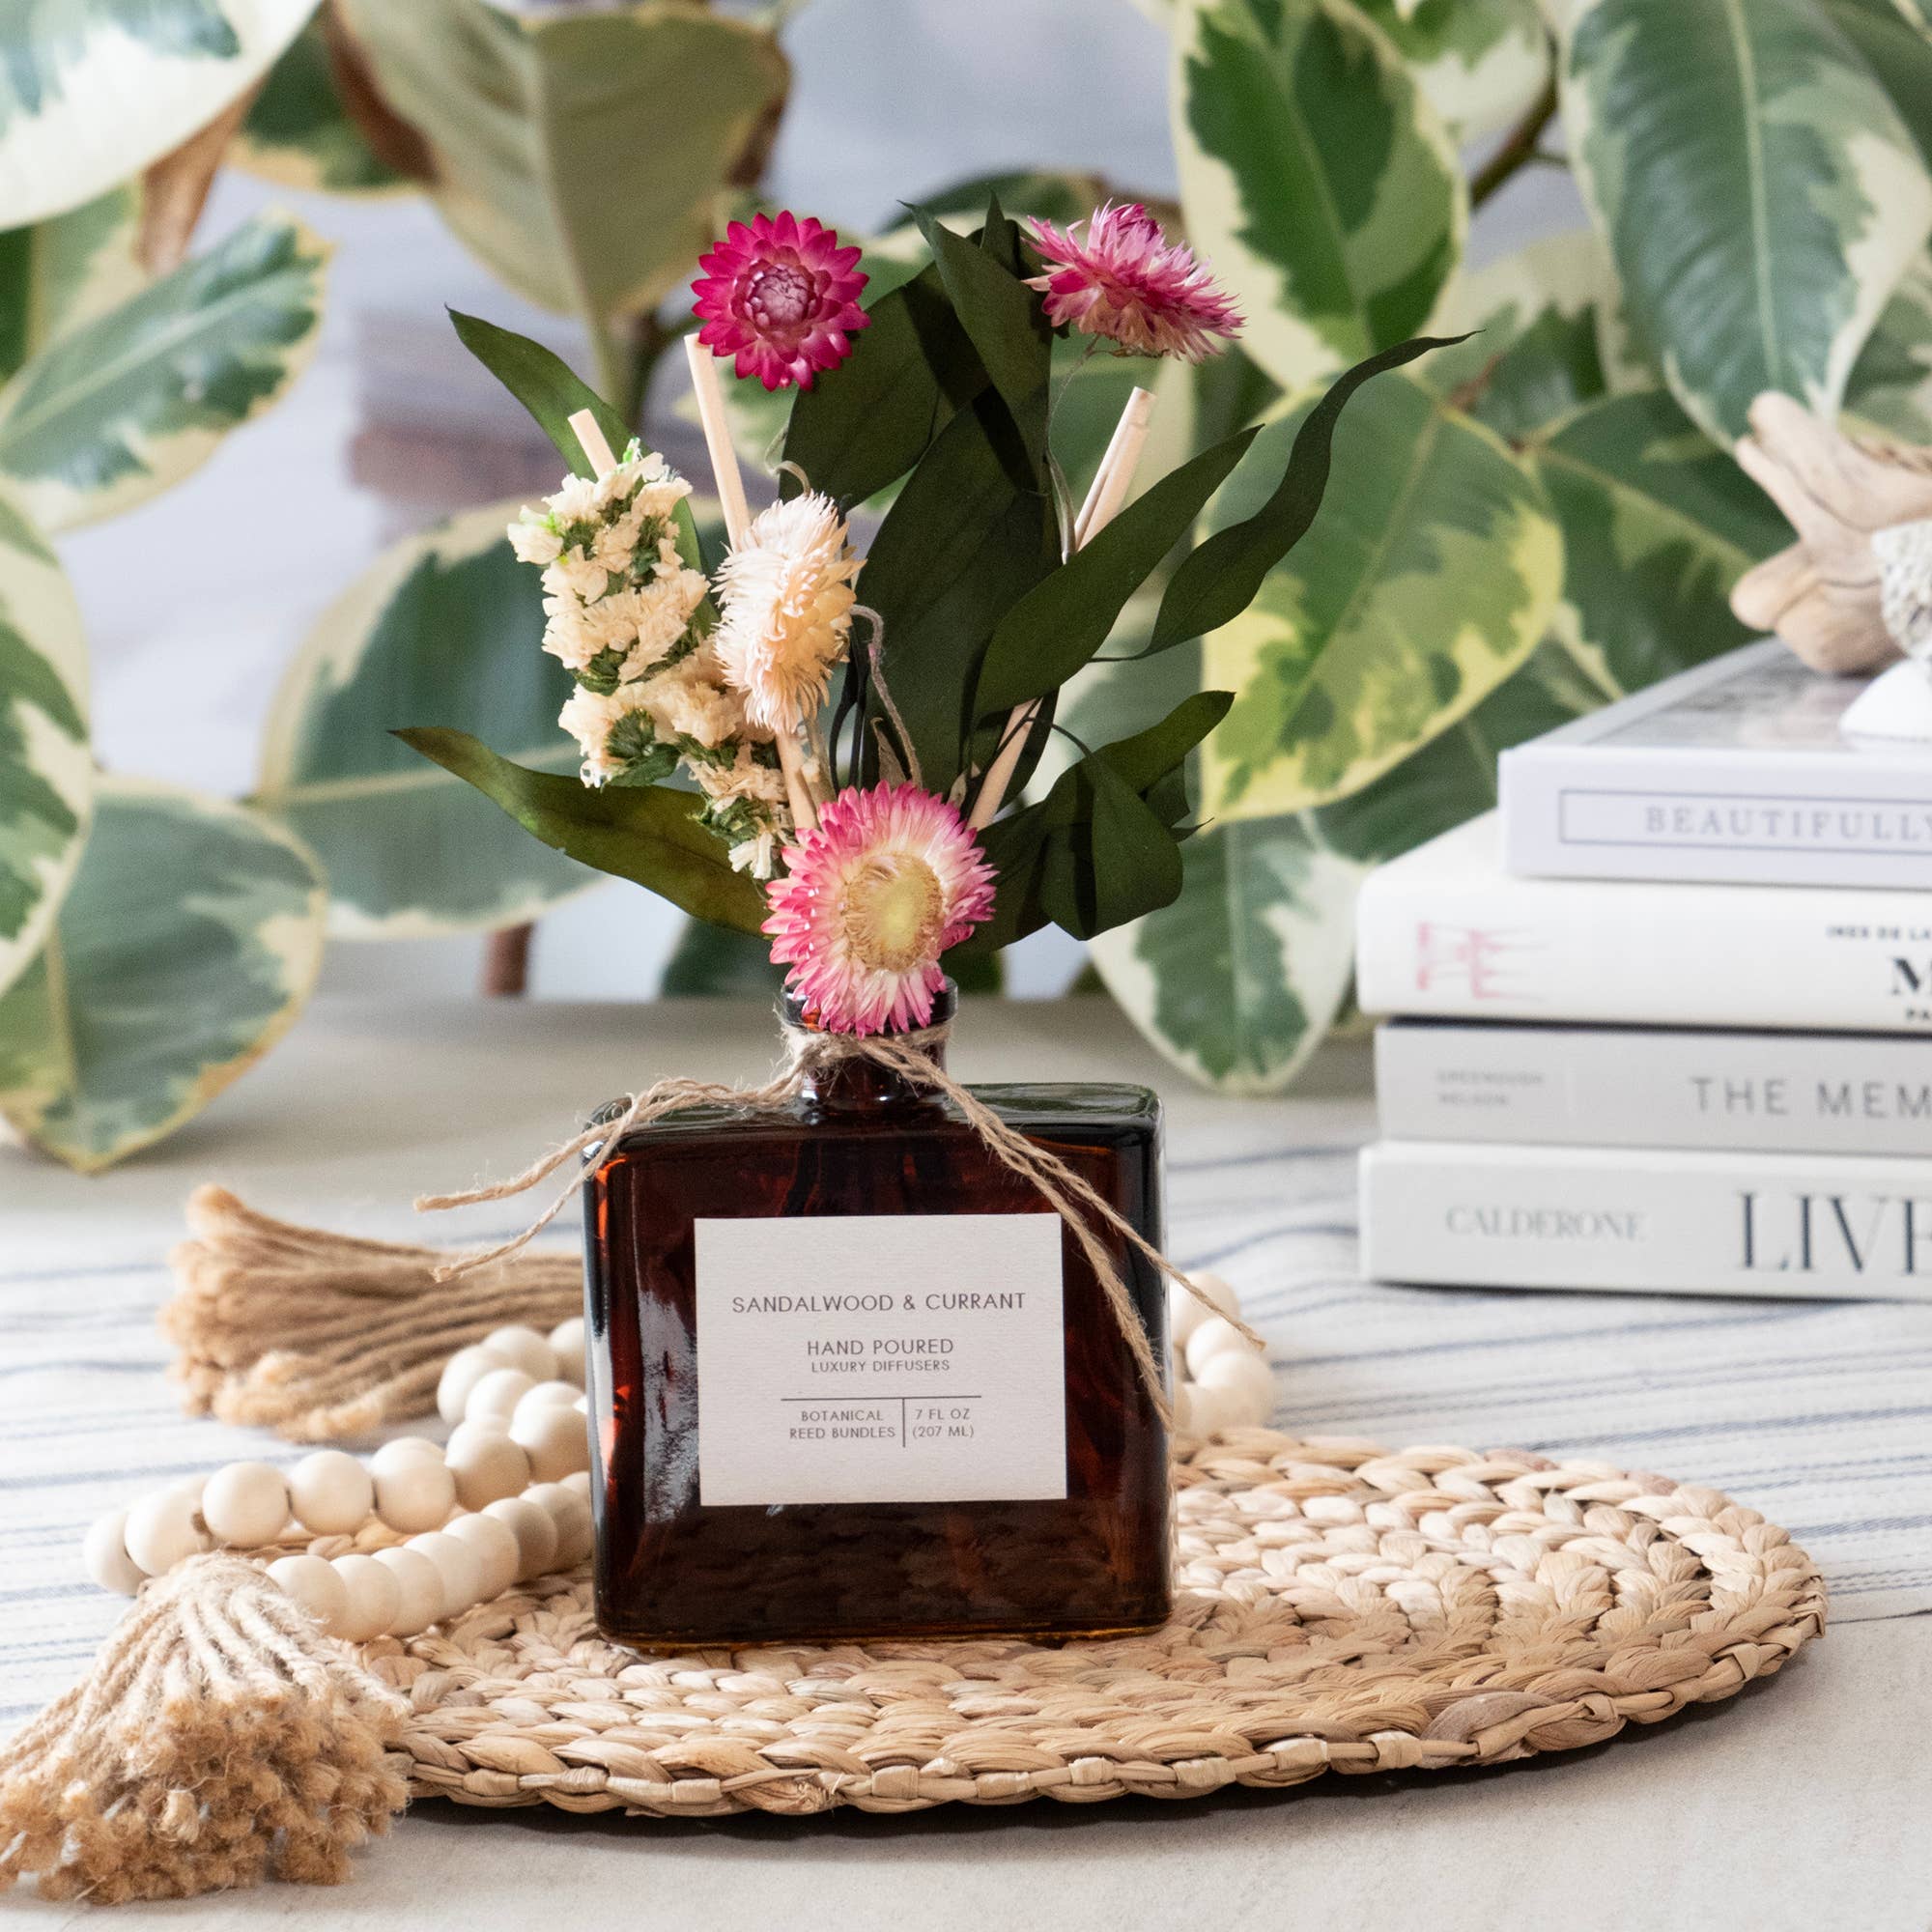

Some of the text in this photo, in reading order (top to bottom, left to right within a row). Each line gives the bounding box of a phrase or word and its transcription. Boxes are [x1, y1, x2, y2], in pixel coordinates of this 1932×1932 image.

[1690, 1076, 1932, 1119] THE MEM
[1445, 1206, 1648, 1242] CALDERONE
[732, 1292, 1026, 1314] SANDALWOOD & CURRANT
[807, 1338, 954, 1356] HAND POURED
[810, 1359, 951, 1374] LUXURY DIFFUSERS
[801, 1409, 884, 1423] BOTANICAL
[915, 1407, 972, 1421] 7 FL OZ
[789, 1426, 896, 1440] REED BUNDLES
[912, 1424, 976, 1440] (207 ML)
